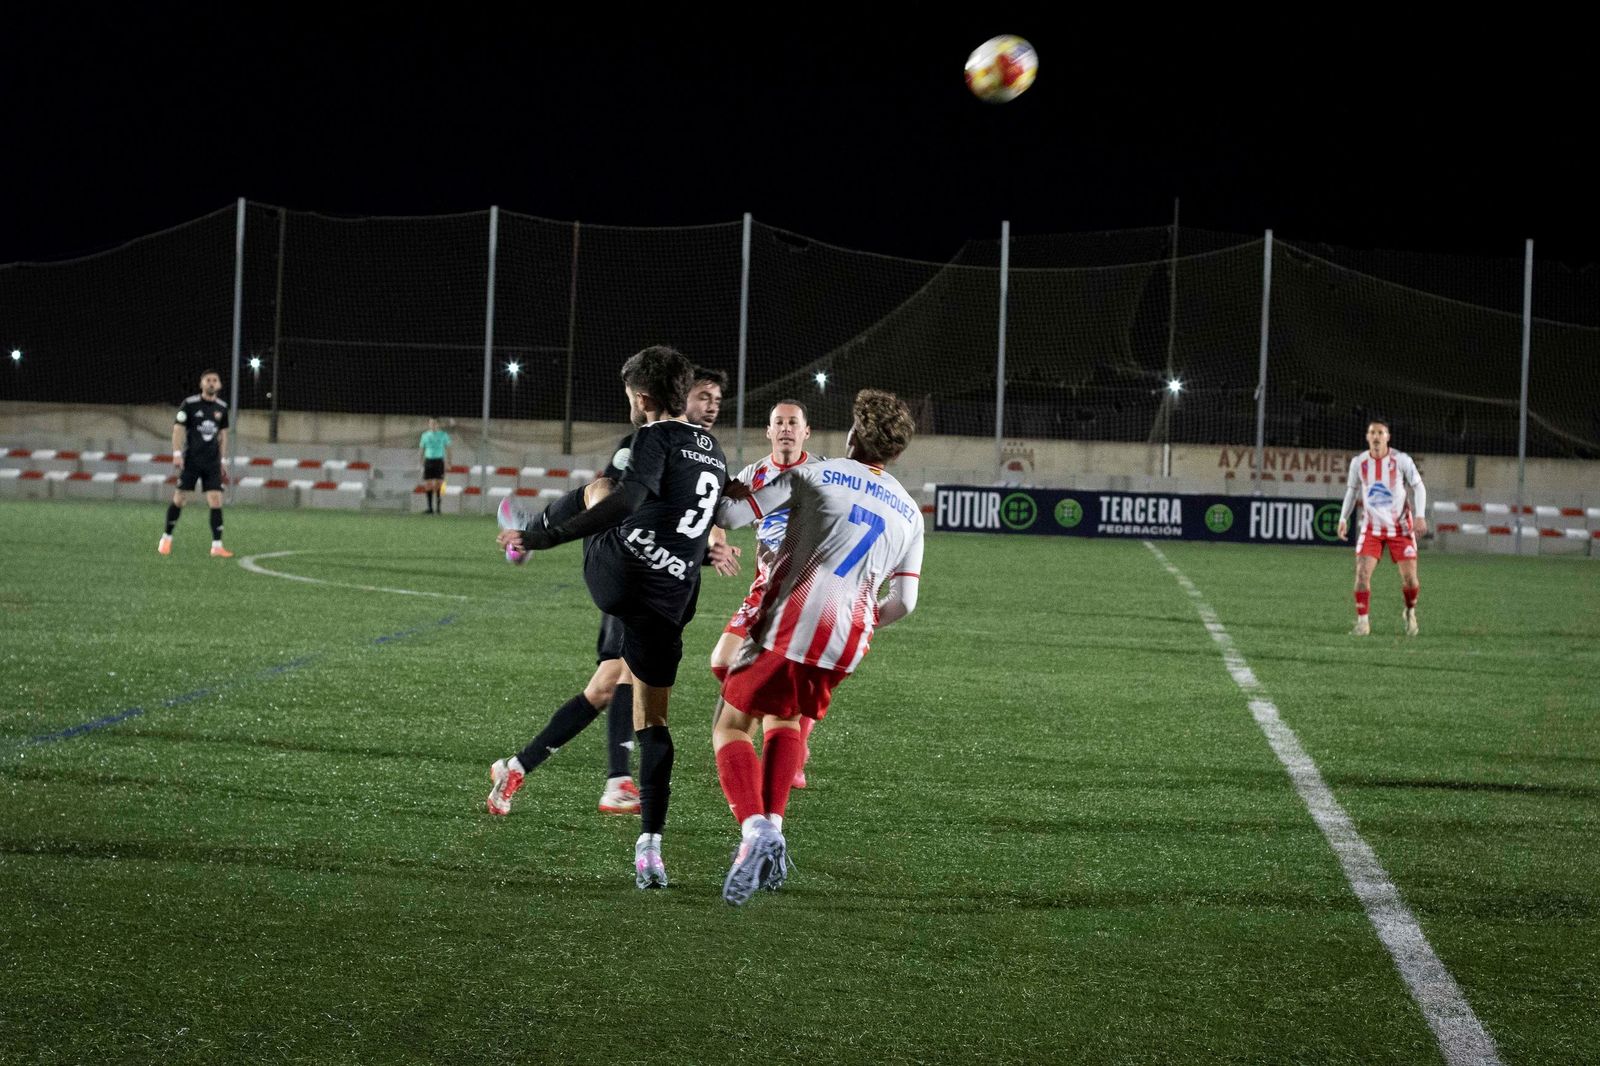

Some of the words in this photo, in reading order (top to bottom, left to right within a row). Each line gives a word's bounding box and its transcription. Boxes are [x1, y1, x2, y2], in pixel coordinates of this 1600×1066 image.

[822, 469, 861, 491] SAMU
[676, 471, 720, 539] 3
[1099, 496, 1182, 524] TERCERA
[833, 503, 886, 578] 7
[1098, 522, 1182, 536] FEDERACIÓN
